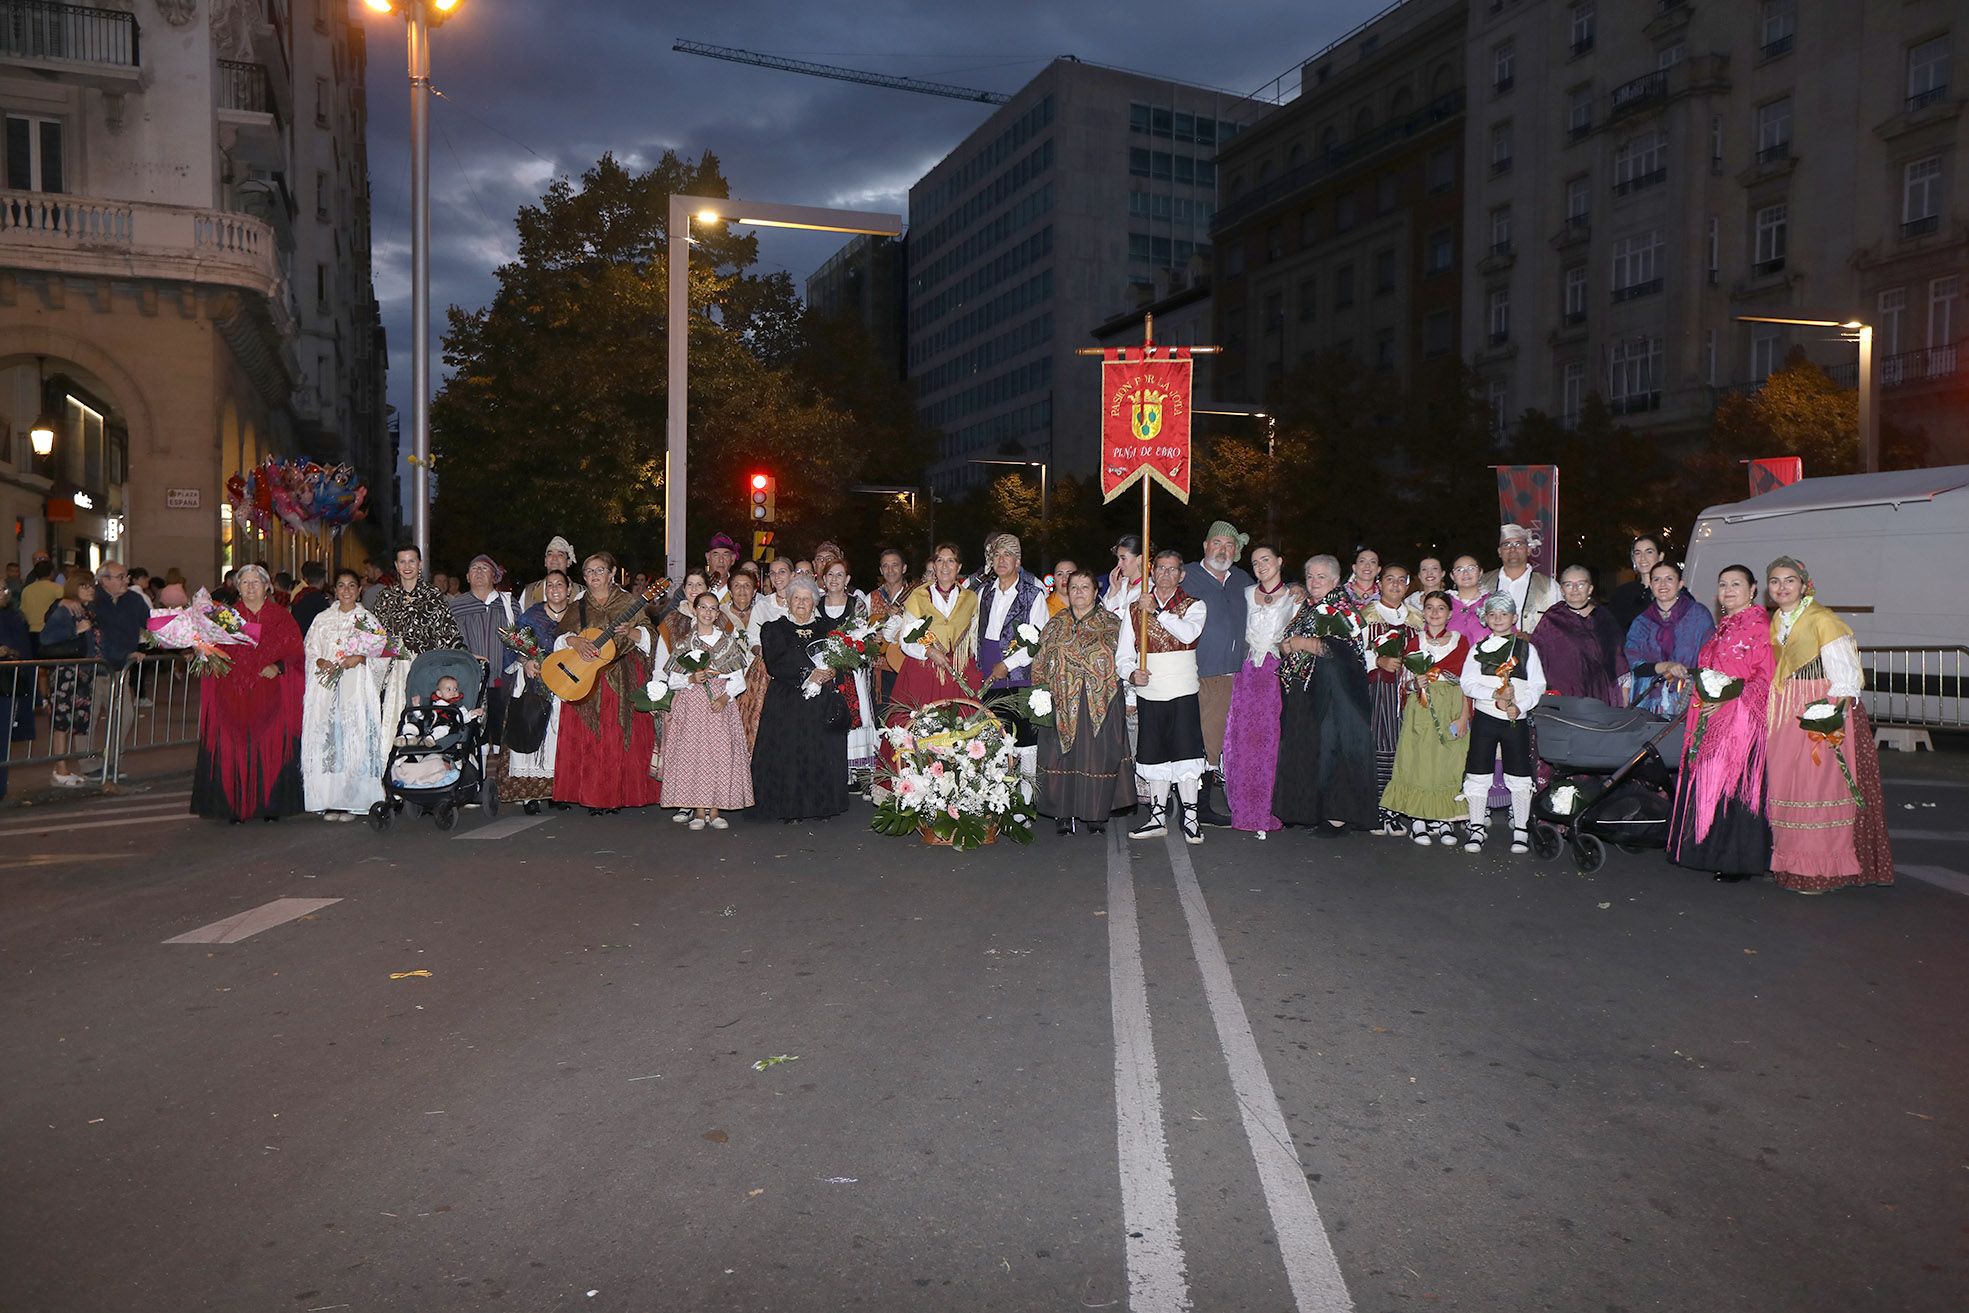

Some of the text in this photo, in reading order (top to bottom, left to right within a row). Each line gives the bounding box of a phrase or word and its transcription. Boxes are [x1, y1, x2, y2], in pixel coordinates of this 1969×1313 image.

[1157, 377, 1170, 391] LA
[1169, 390, 1183, 416] JOTA
[1140, 446, 1152, 457] DE
[1155, 446, 1180, 459] EBRO
